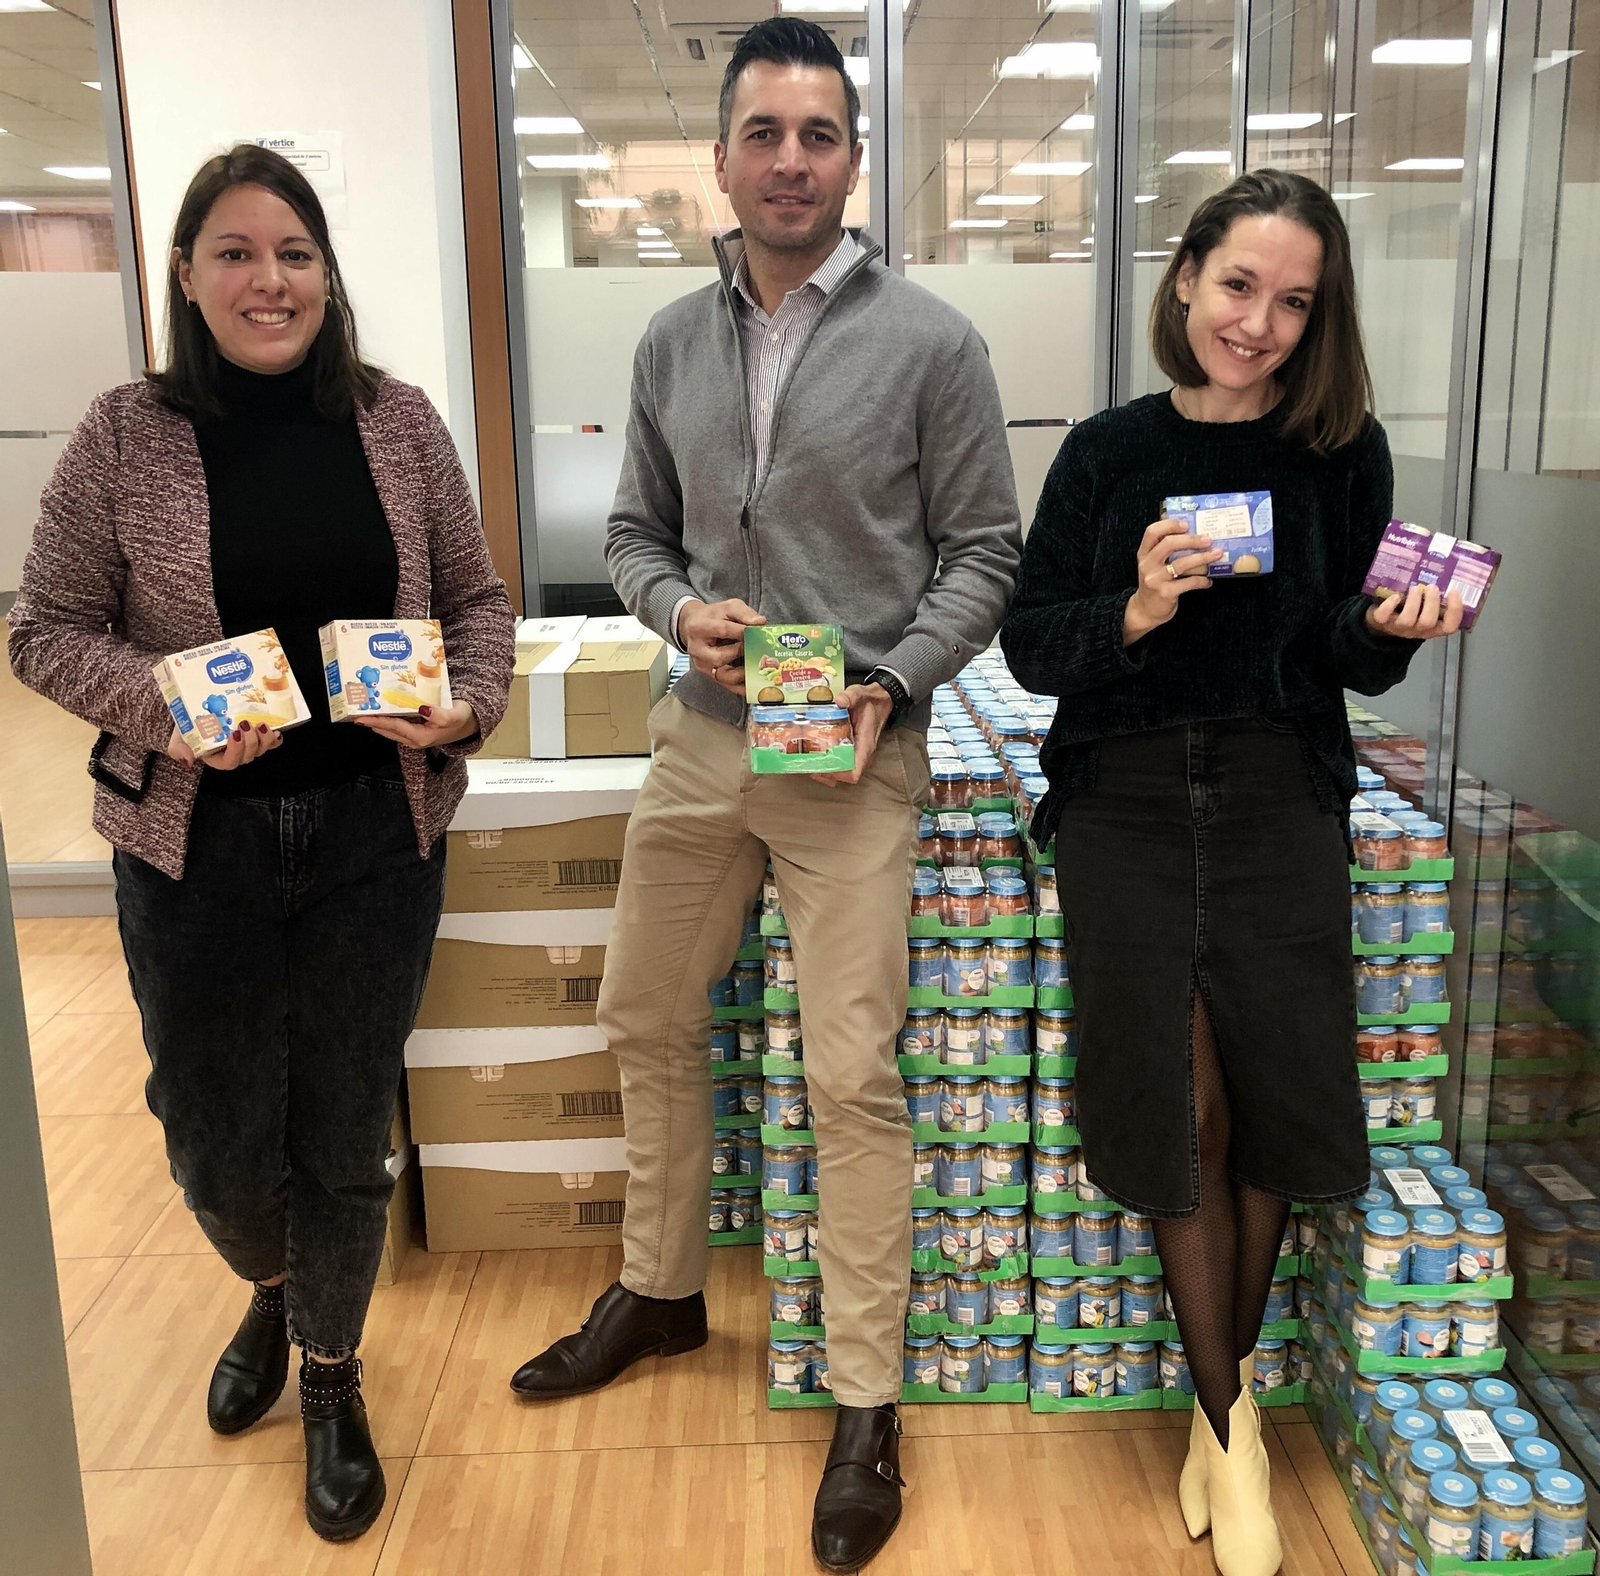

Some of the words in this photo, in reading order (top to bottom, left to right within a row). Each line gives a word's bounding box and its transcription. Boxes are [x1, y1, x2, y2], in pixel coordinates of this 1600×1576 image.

[341, 624, 348, 634] 6
[781, 635, 806, 643] Hero
[372, 640, 407, 651] Nestlé
[174, 658, 182, 667] 6
[210, 658, 248, 678] Nestlé
[391, 664, 408, 672] gluten
[236, 684, 254, 694] gluten
